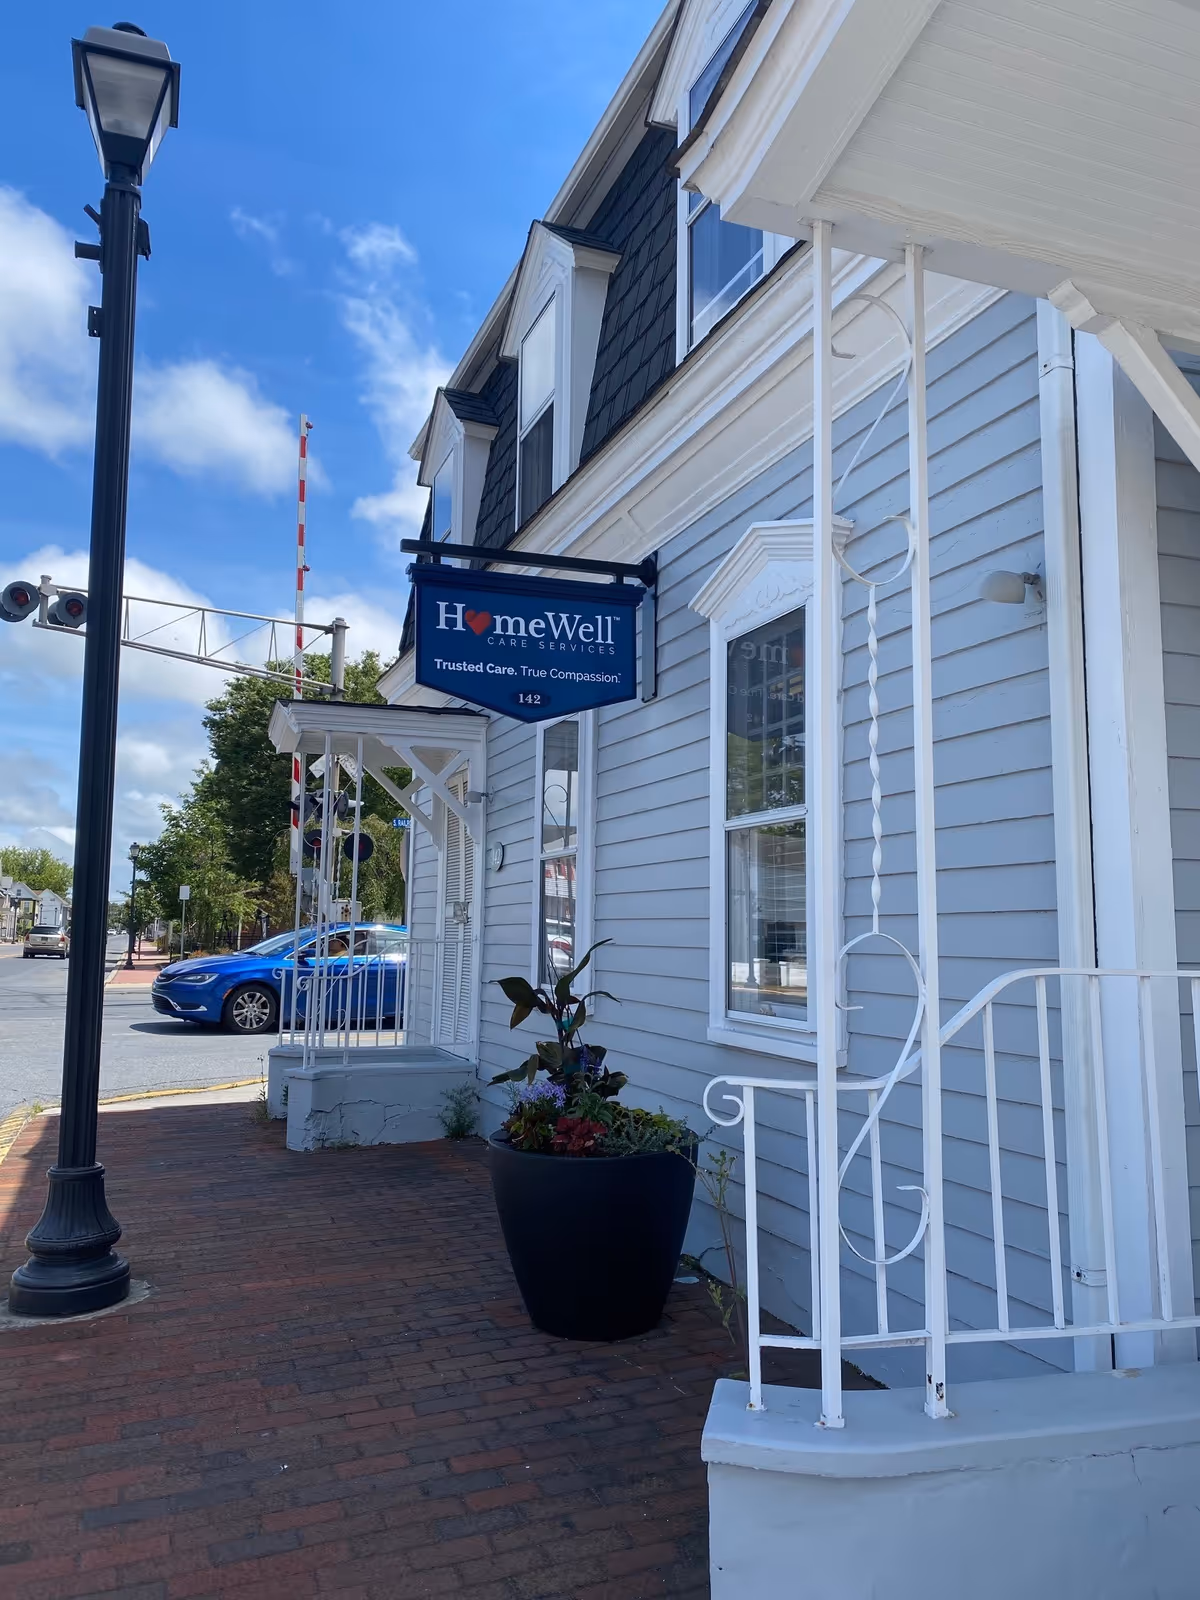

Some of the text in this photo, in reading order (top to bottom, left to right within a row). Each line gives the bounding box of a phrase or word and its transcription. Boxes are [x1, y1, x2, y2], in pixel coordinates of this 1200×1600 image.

[487, 636, 616, 655] CARE SERVICES
[434, 658, 484, 673] Trusted
[486, 663, 518, 676] Care.
[520, 665, 547, 678] True
[518, 693, 541, 705] 142
